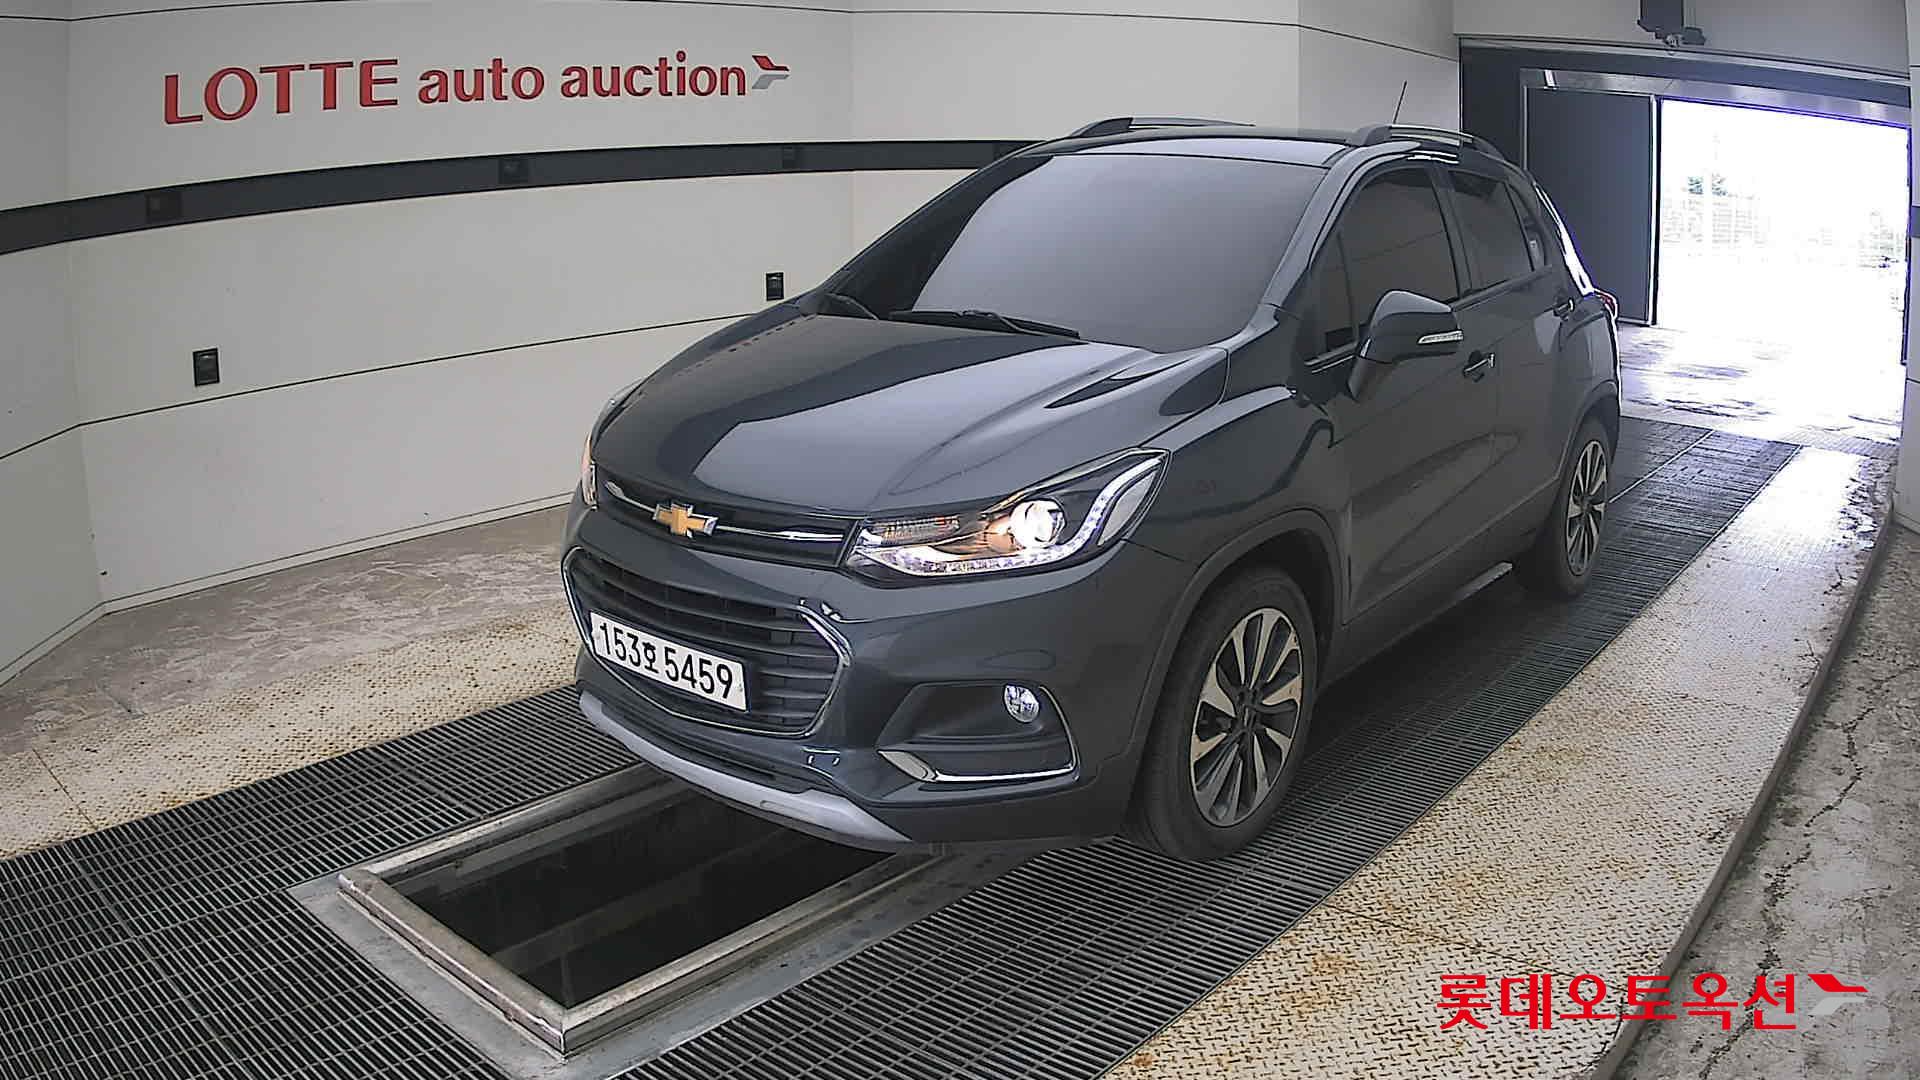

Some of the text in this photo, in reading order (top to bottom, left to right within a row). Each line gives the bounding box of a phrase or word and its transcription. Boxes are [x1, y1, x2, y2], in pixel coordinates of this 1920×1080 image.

[163, 50, 747, 125] LOTTE auto auction
[600, 622, 733, 699] 153호 5459
